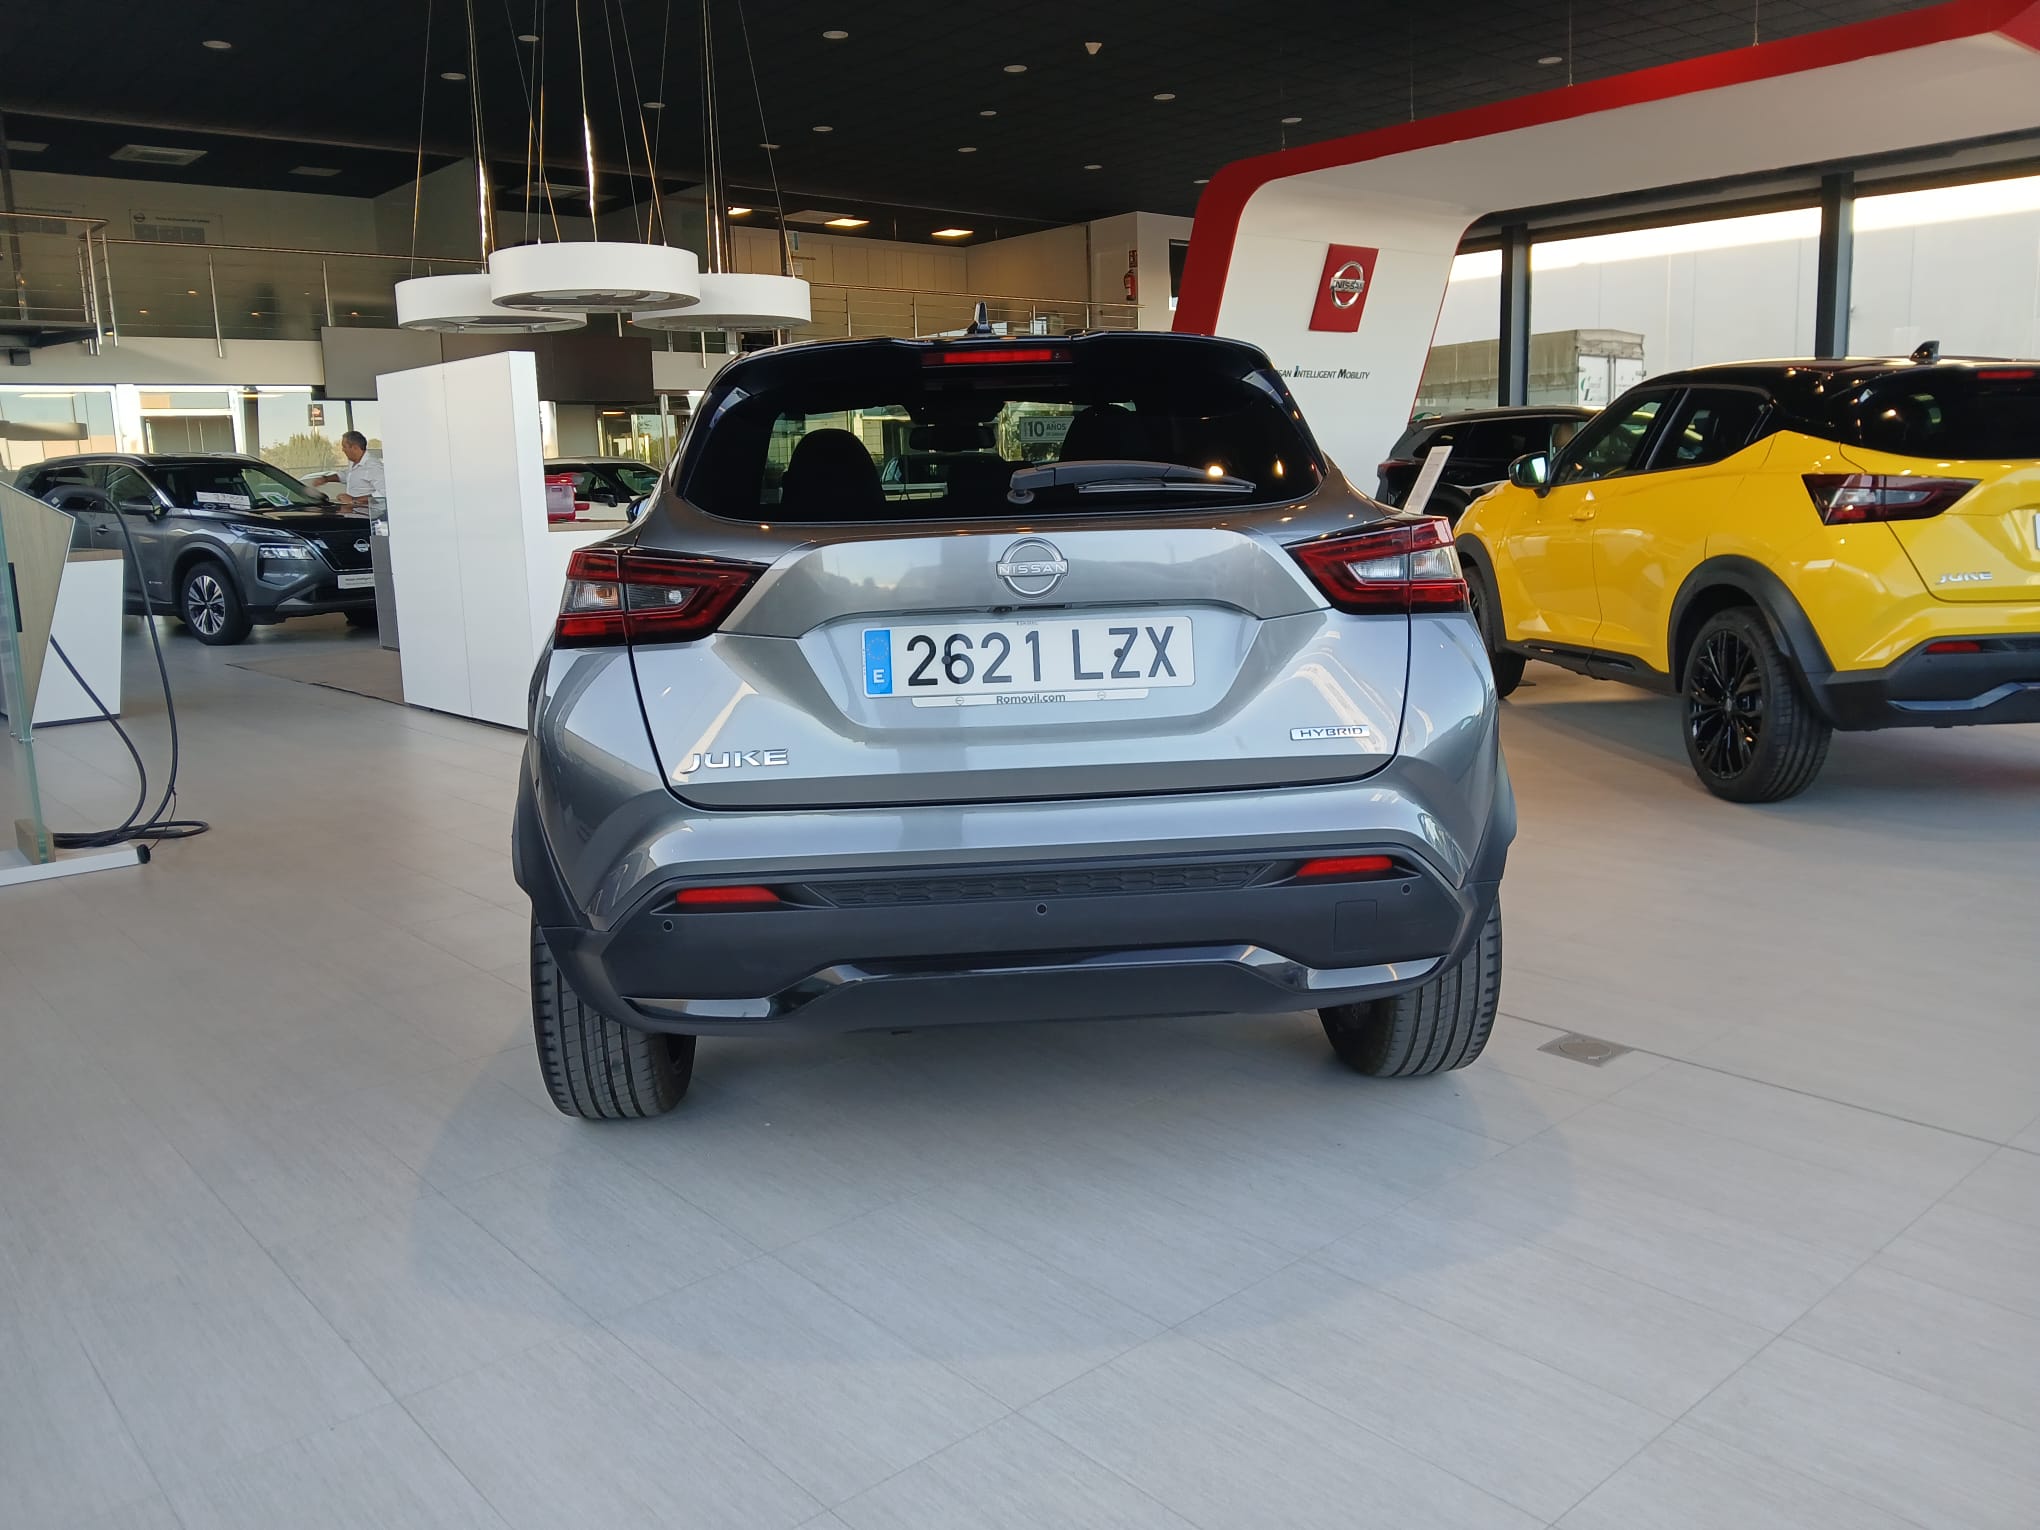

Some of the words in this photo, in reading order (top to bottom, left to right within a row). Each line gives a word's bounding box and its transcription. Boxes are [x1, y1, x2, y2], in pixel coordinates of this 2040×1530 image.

[1293, 365, 1337, 379] INTELLIGENT
[1337, 368, 1370, 380] MOBILITY
[999, 563, 1065, 574] NISSAN
[1935, 571, 1993, 585] JUKE
[906, 630, 1041, 687] 2621
[1071, 626, 1177, 681] LZX
[873, 668, 885, 684] E
[996, 694, 1066, 705] Romovil.com
[1300, 727, 1363, 738] HYBRID
[680, 748, 789, 775] JUKE
